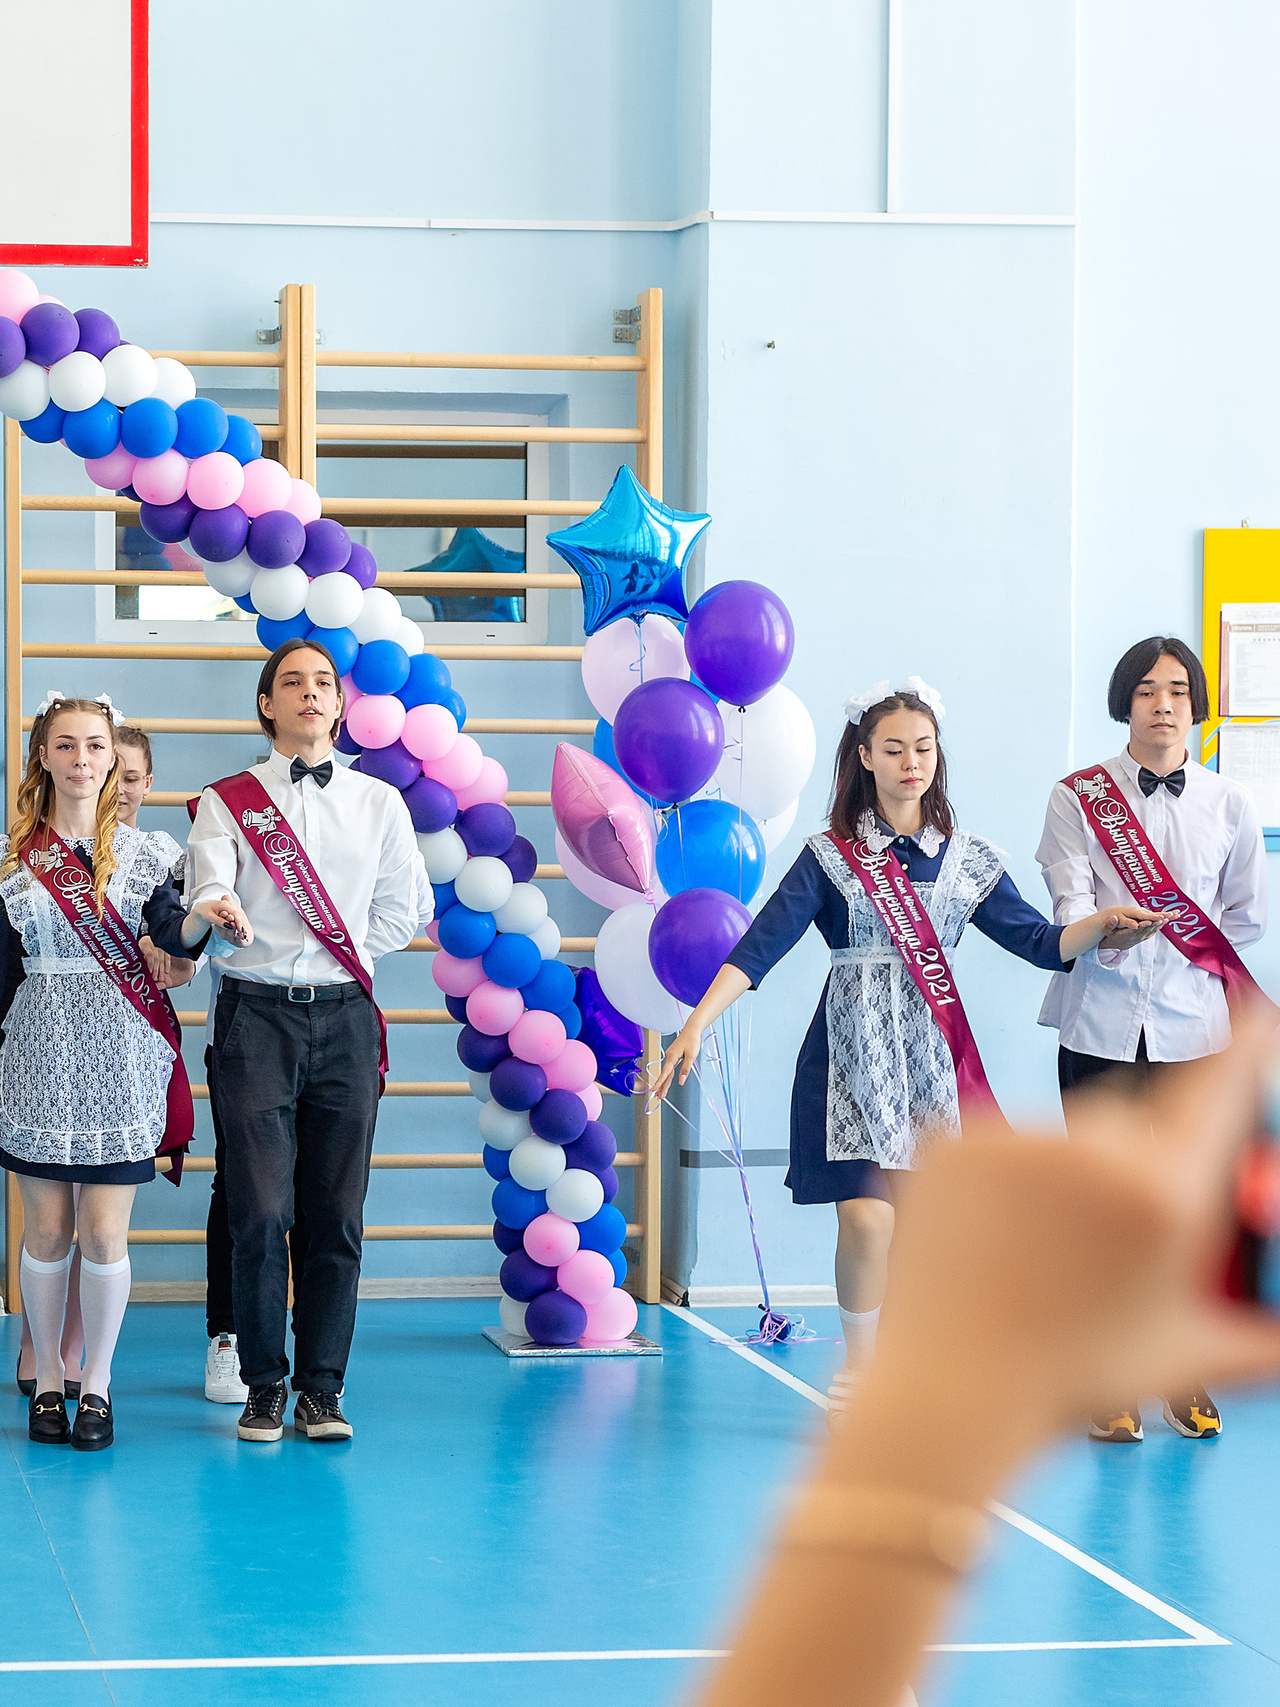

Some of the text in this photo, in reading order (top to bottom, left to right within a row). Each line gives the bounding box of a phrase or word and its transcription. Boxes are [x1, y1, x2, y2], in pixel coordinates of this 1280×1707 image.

[263, 831, 326, 932] Выпускник
[295, 858, 338, 929] Гудков Константин
[1092, 797, 1206, 942] Выпускник 2021
[1126, 828, 1141, 844] Ким
[1137, 845, 1163, 883] Владимир
[53, 866, 155, 1011] Выпускница 2021
[852, 838, 956, 1007] Выпускница 2021
[894, 876, 922, 922] Сим Ирина
[122, 940, 138, 961] Дарья
